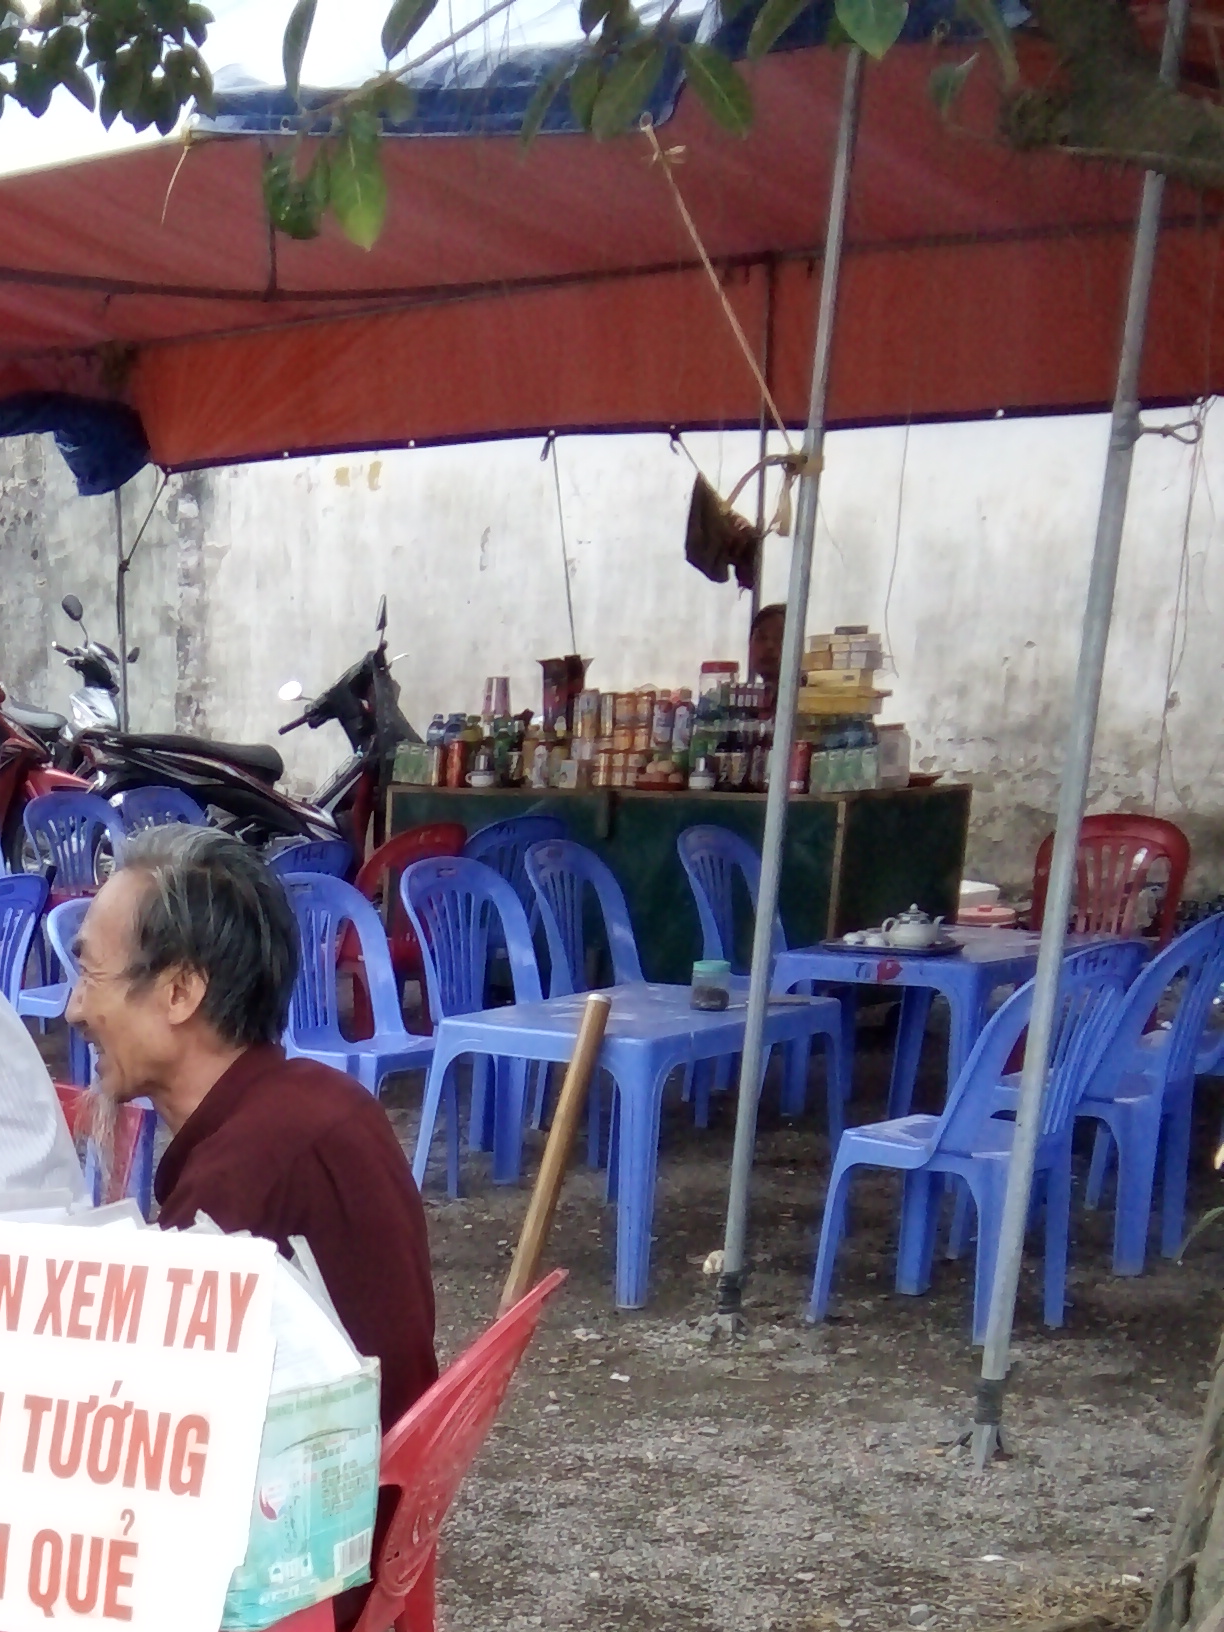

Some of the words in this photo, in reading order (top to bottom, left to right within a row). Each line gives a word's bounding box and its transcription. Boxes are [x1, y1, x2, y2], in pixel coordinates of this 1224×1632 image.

[33, 1258, 146, 1343] XEM
[163, 1267, 260, 1353] TAY
[22, 1380, 210, 1497] TƯỚNG
[28, 1508, 139, 1622] QUẺ
